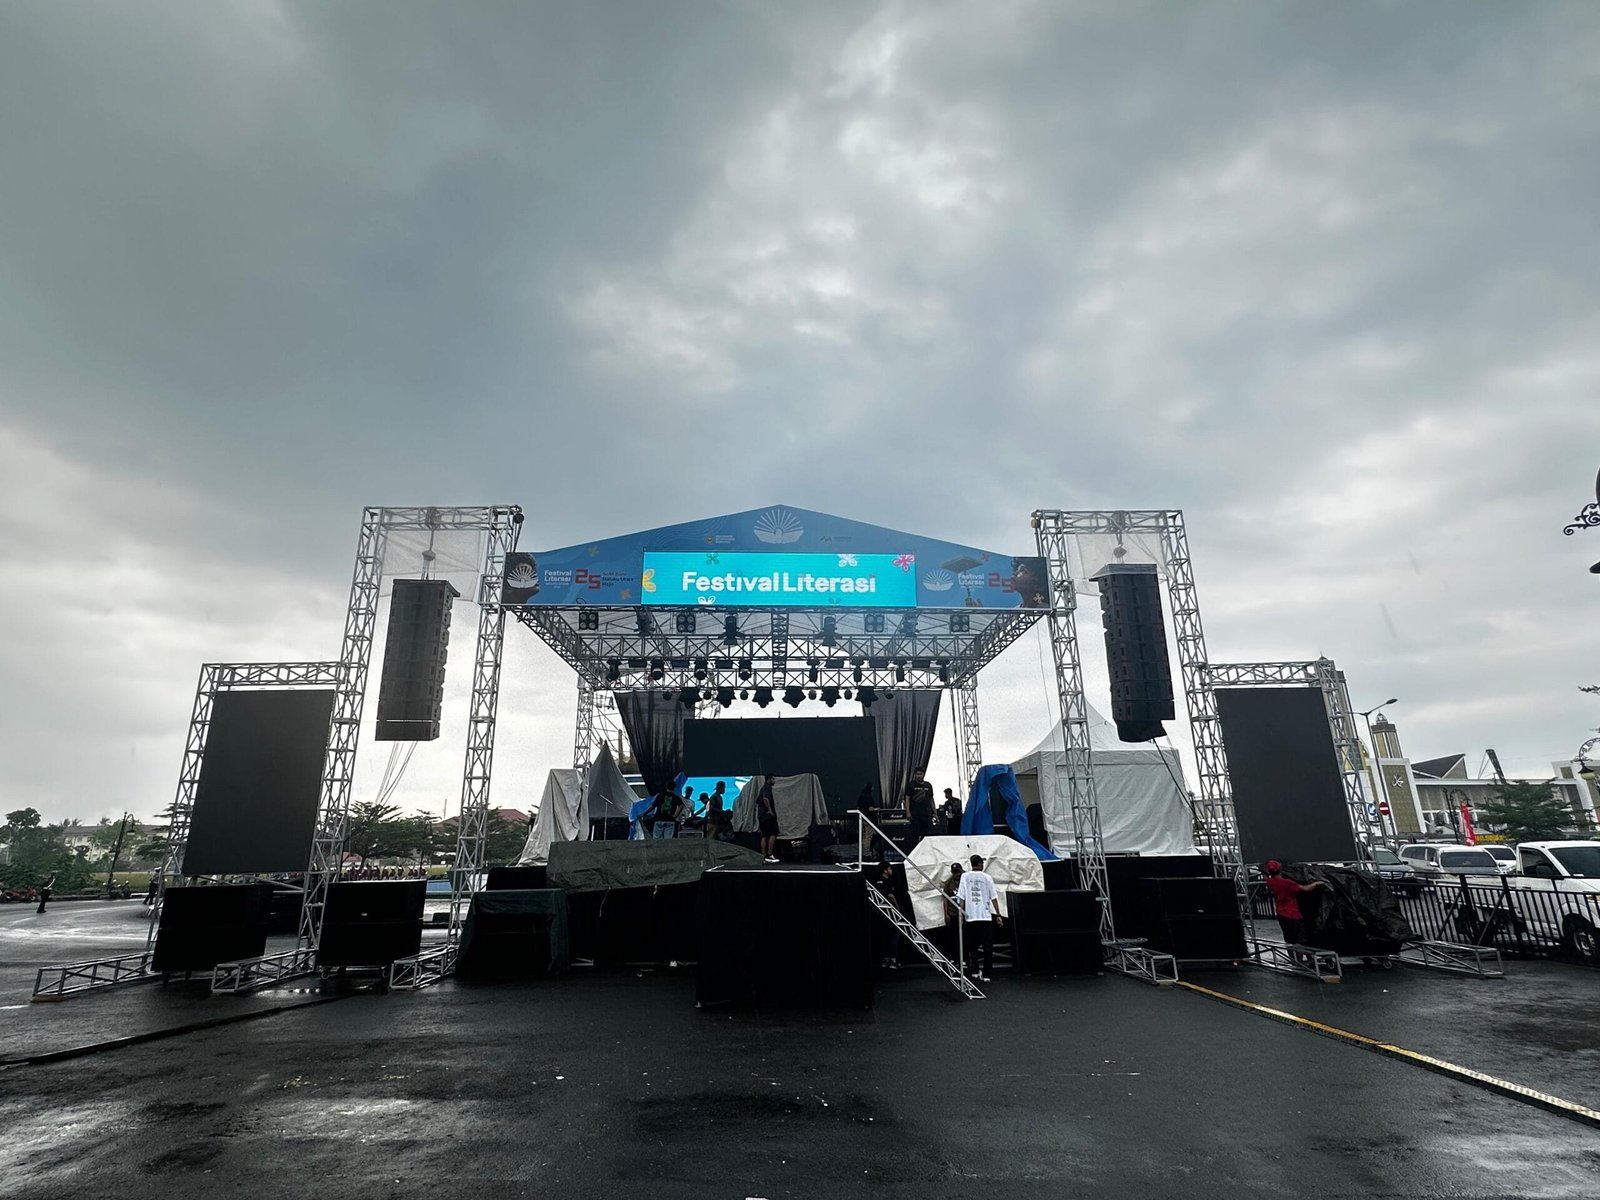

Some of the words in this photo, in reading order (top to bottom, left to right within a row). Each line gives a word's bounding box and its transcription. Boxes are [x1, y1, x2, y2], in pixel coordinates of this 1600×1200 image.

[575, 568, 601, 590] 25
[682, 571, 779, 592] Festival
[783, 571, 876, 593] Literasi
